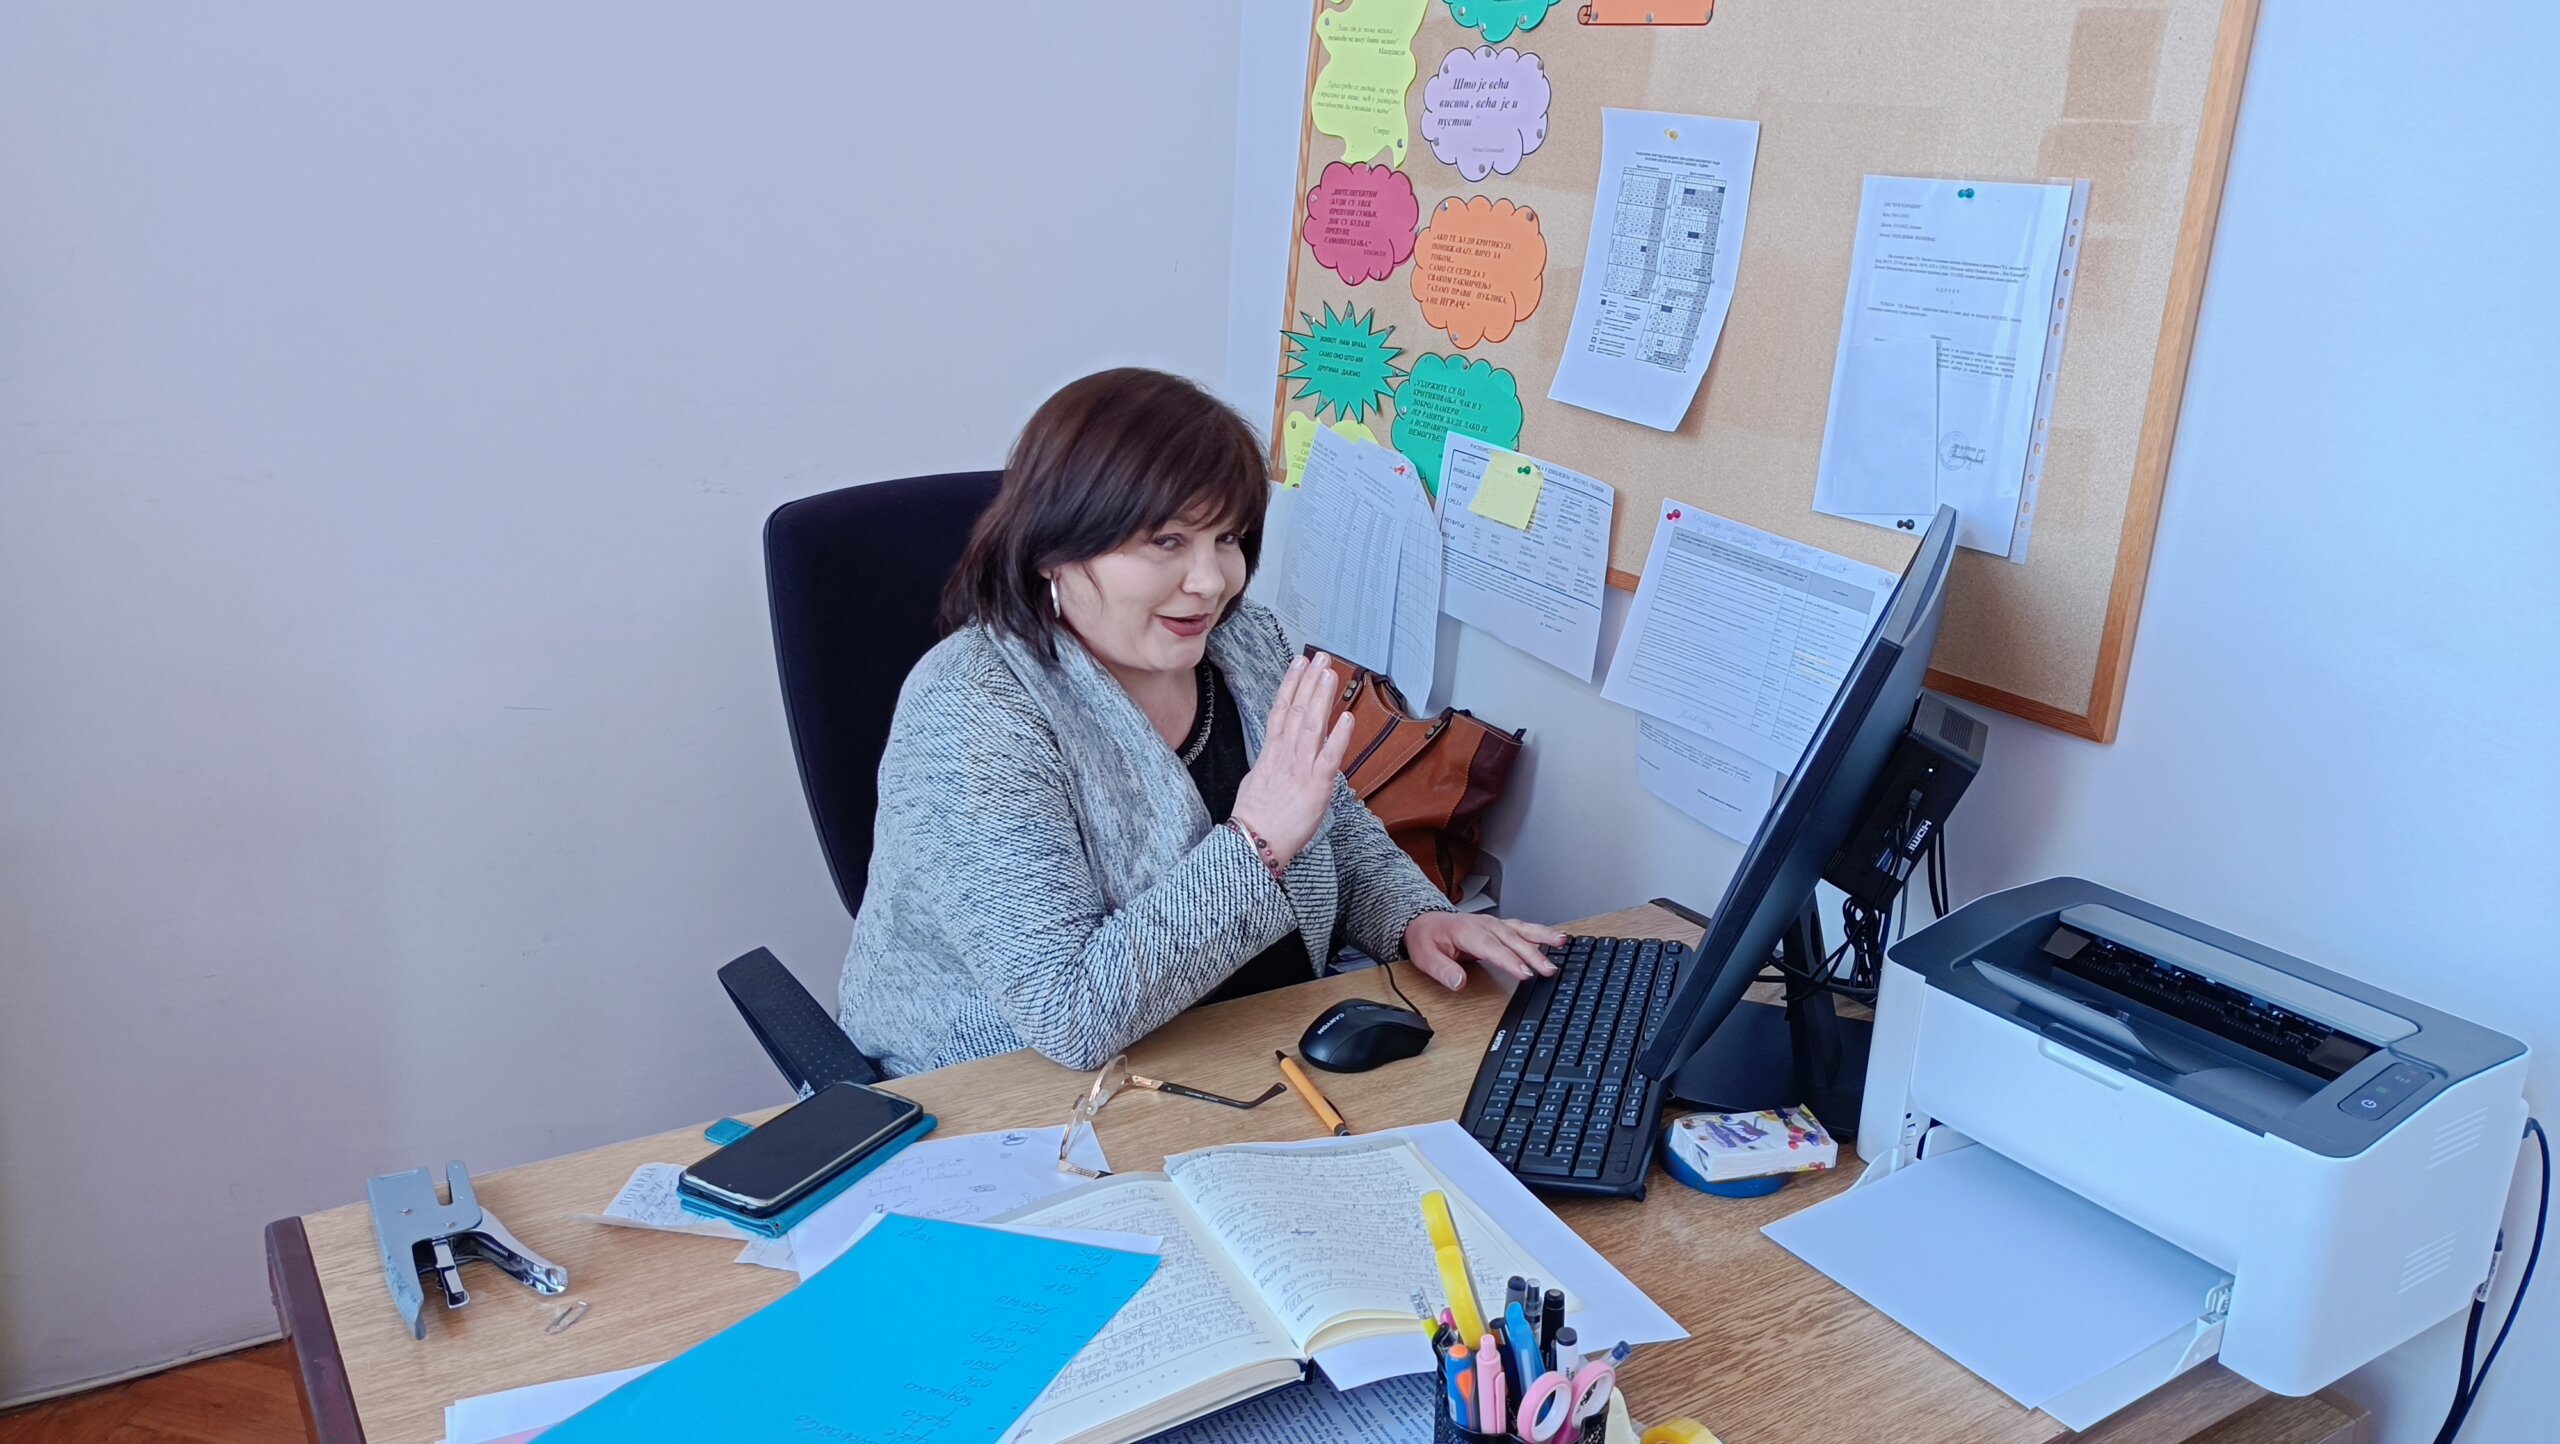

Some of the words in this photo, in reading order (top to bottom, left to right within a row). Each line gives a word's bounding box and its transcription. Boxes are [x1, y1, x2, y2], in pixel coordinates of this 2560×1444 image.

[1476, 77, 1487, 93] је
[1488, 77, 1510, 90] већа
[1475, 96, 1497, 109] већа
[1498, 97, 1510, 112] је
[1512, 100, 1519, 109] и
[1908, 819, 1932, 855] HDMI
[1317, 1012, 1345, 1035] CANYON
